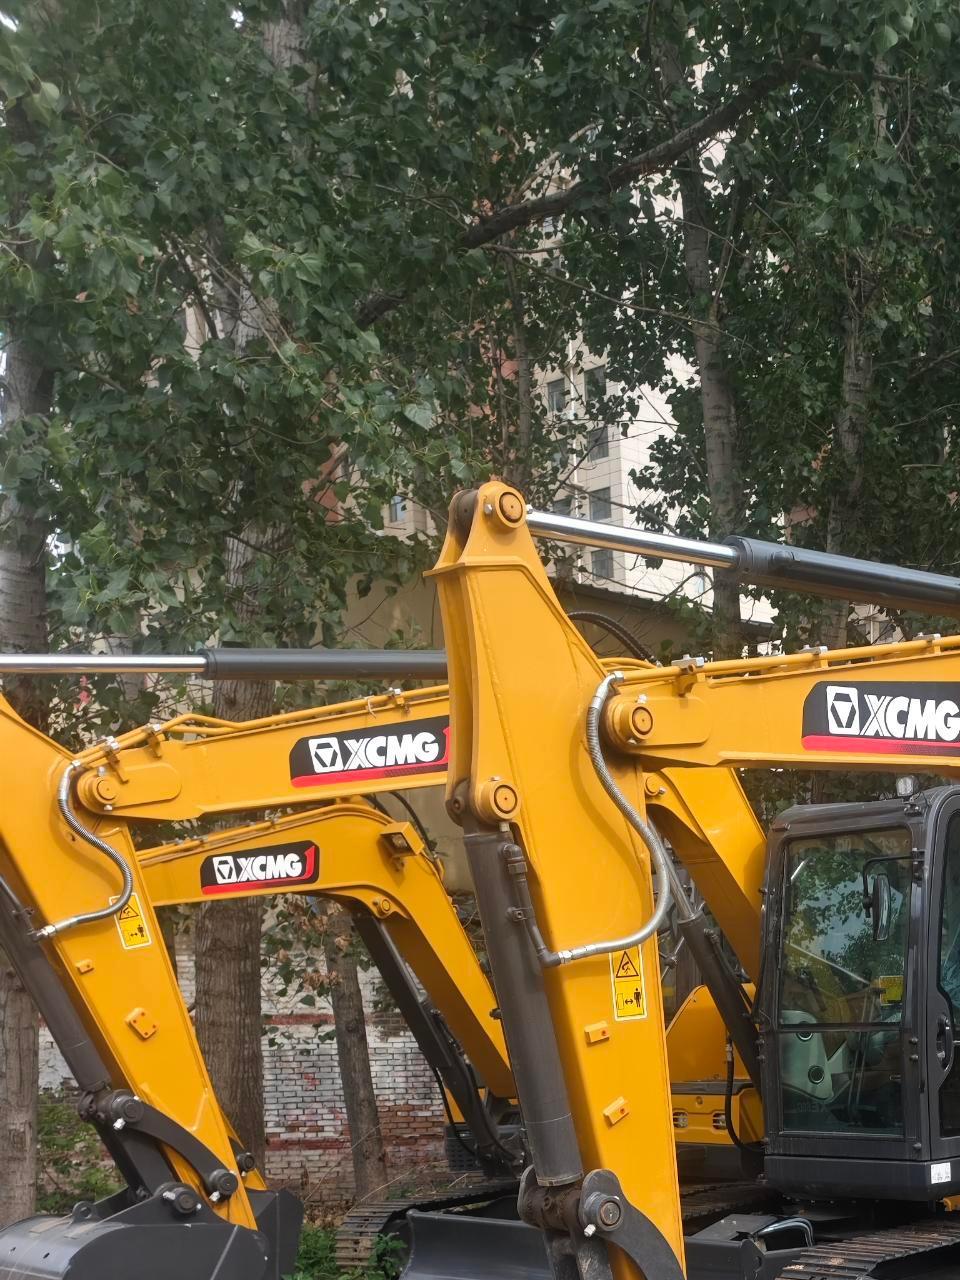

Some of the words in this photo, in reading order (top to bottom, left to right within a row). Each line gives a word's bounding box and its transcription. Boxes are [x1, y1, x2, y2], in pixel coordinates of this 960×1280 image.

[860, 695, 960, 741] XCMG
[344, 732, 439, 770] XCMG
[237, 853, 302, 882] XCMG
